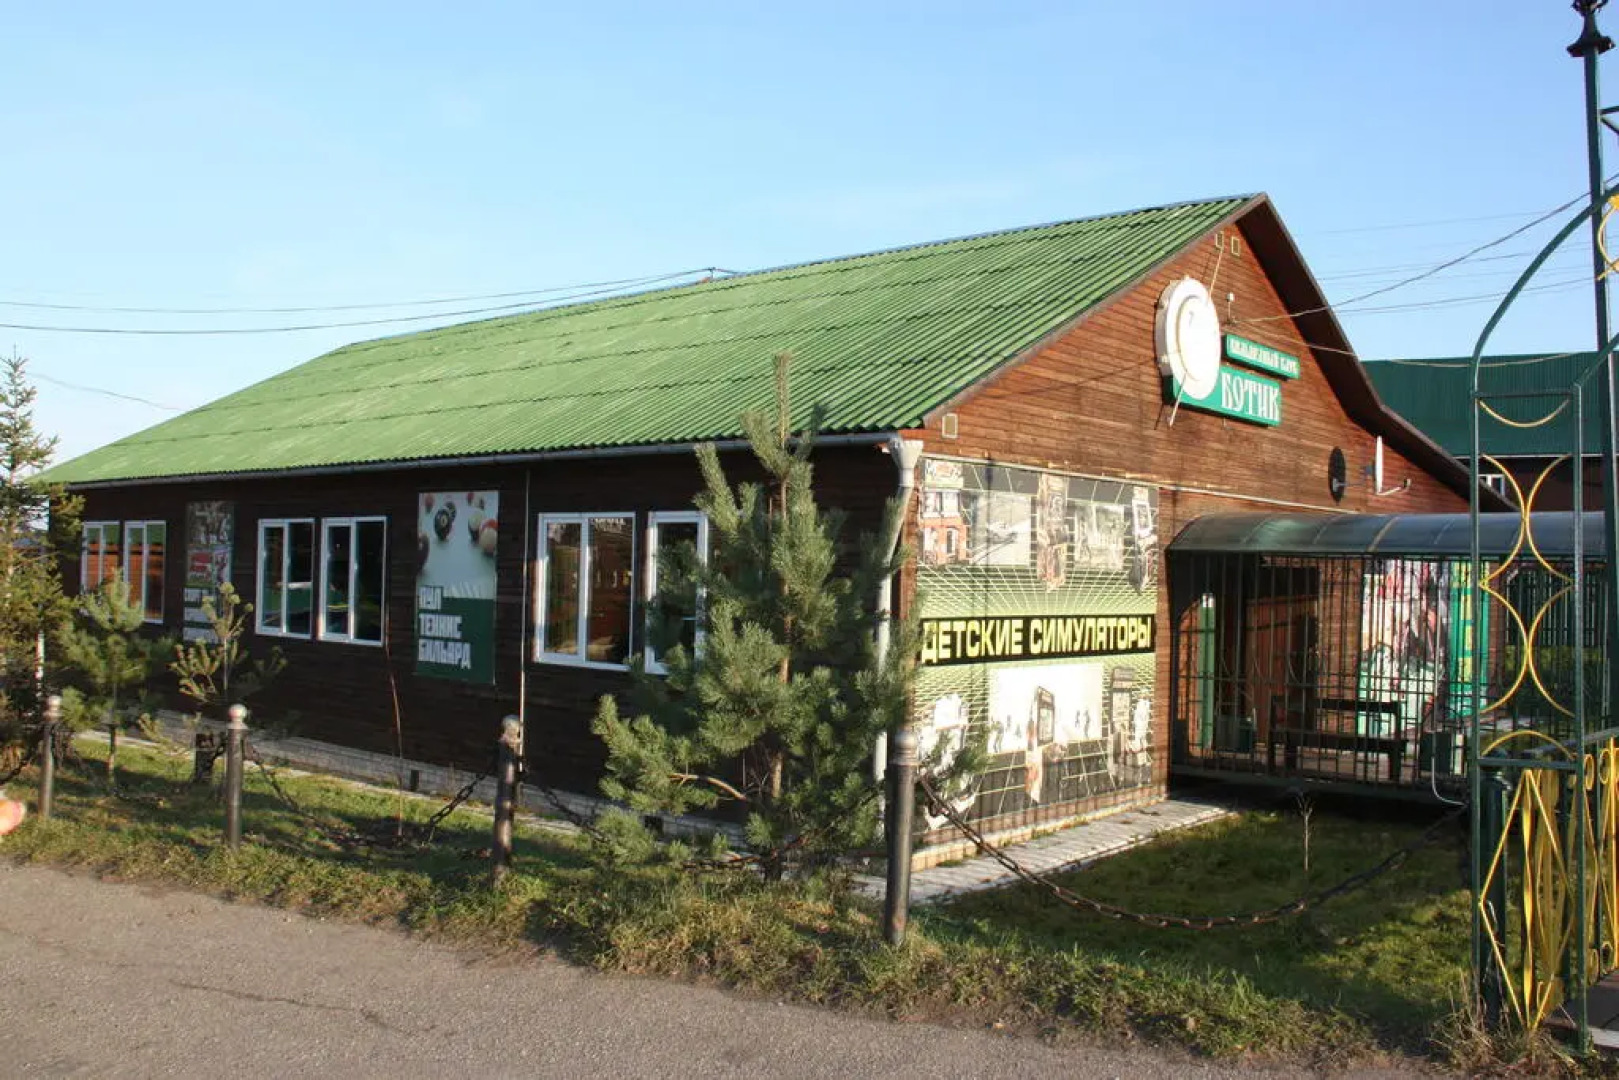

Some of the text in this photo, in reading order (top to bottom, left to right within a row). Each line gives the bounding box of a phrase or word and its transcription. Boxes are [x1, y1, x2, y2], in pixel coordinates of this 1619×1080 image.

[1221, 371, 1280, 422] БОТИК
[418, 613, 463, 639] ТЕННИС
[920, 616, 1152, 664] ДЕТСКИЕ СИМУЛЯТОРЫ
